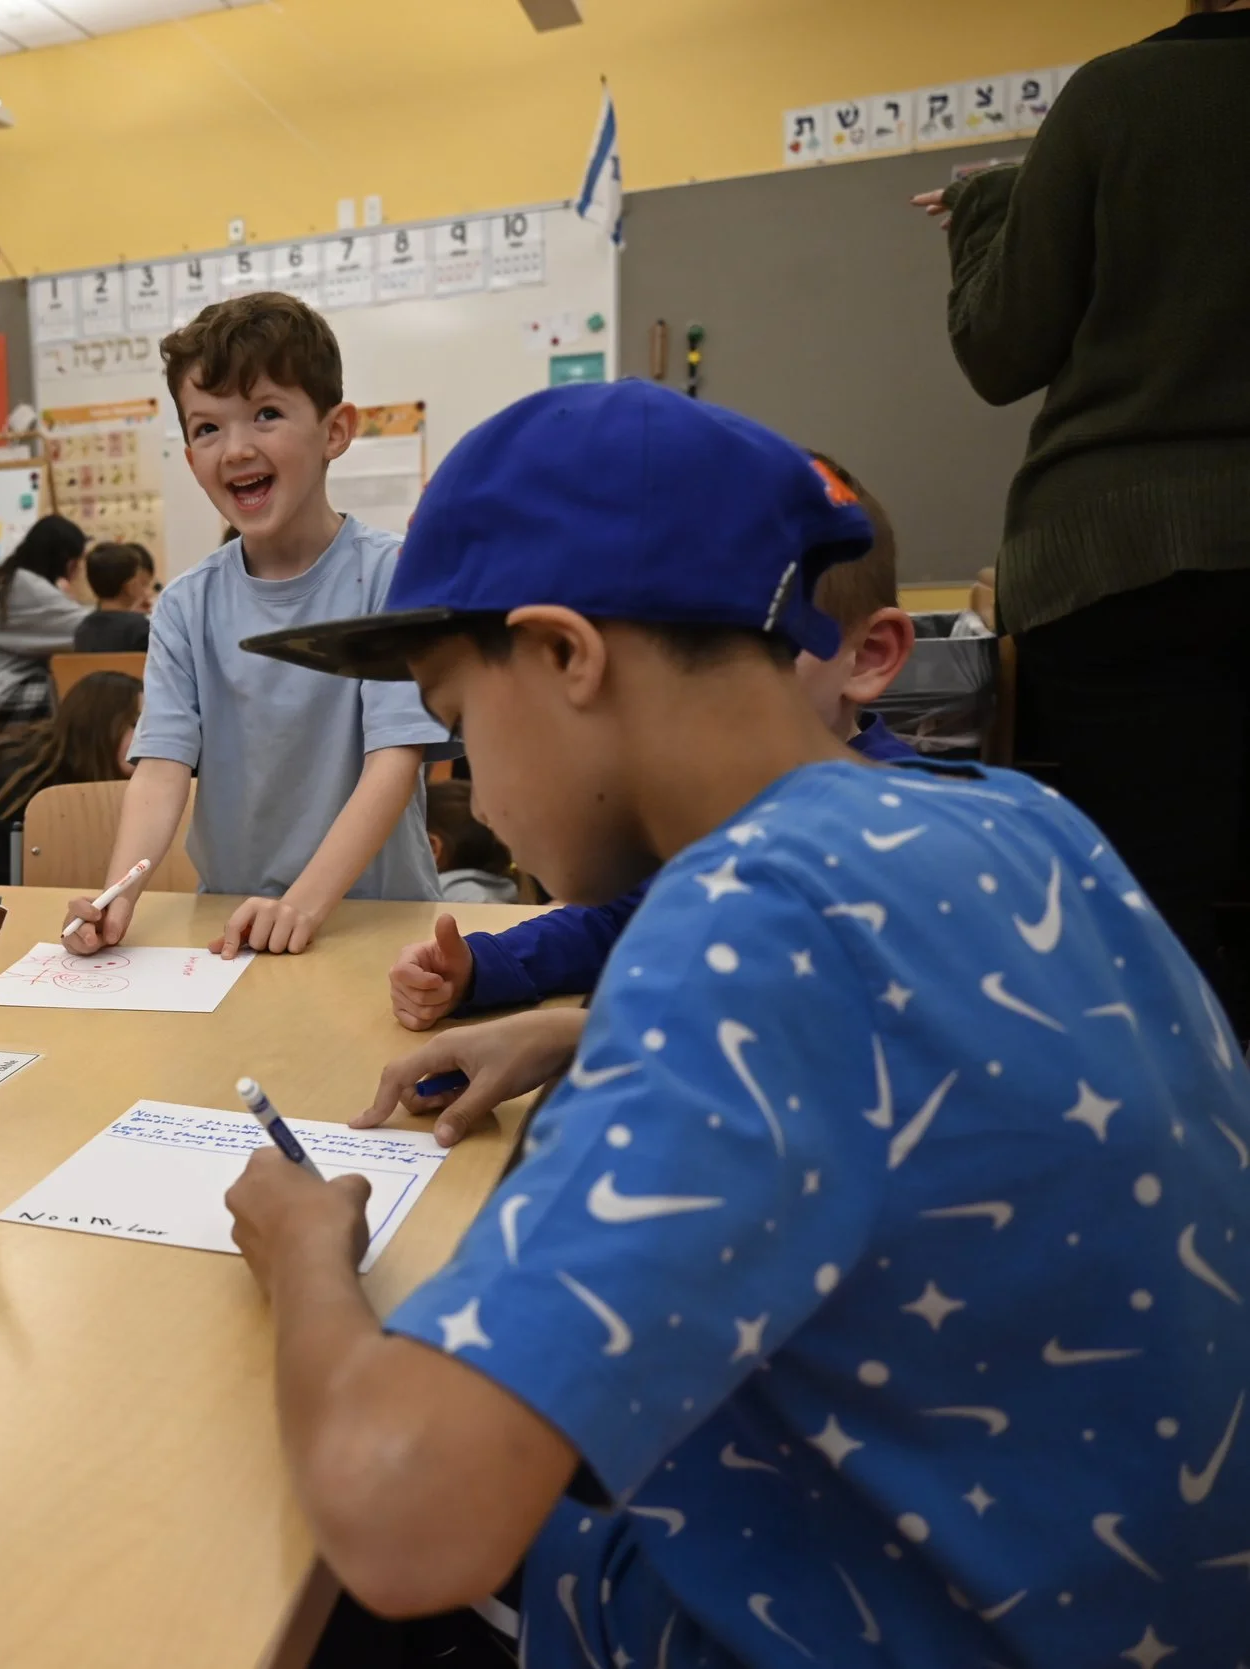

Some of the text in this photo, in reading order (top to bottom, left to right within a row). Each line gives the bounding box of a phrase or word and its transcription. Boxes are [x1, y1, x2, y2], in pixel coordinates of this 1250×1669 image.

[927, 94, 949, 118] ק
[975, 84, 994, 108] צ
[836, 105, 860, 129] ש
[884, 102, 901, 121] ר
[794, 115, 815, 137] ת
[95, 271, 108, 294] 2
[141, 265, 155, 288] 3
[187, 257, 203, 279] 4
[237, 251, 252, 274] 5
[289, 244, 303, 267] 6
[339, 236, 354, 261] 7
[394, 228, 409, 253] 8
[450, 221, 467, 244] 9
[503, 212, 528, 239] 10
[131, 1109, 175, 1121] Noam
